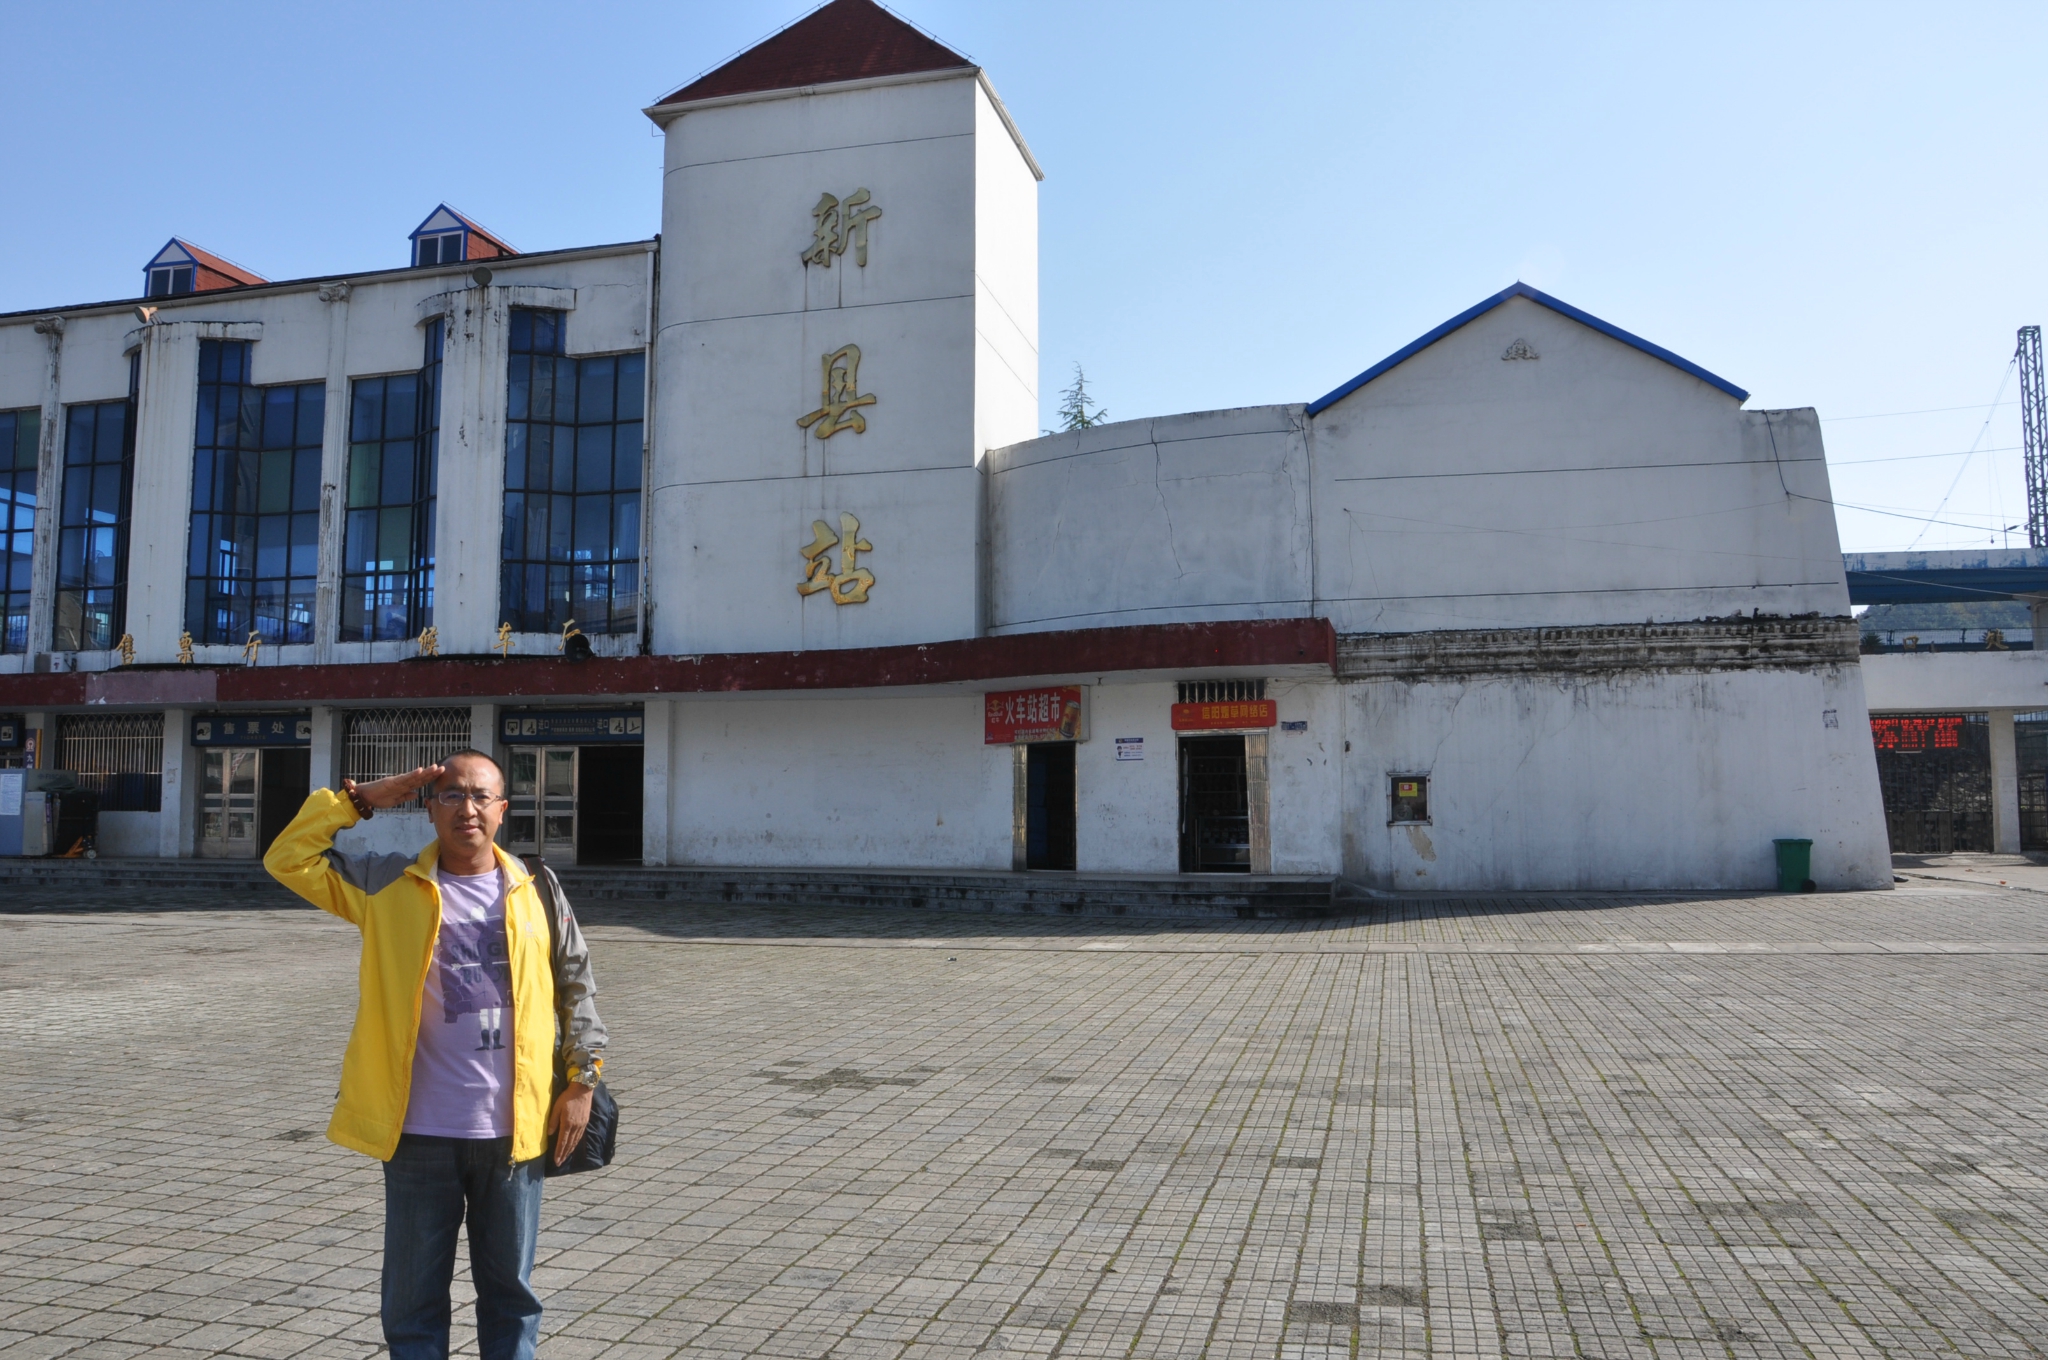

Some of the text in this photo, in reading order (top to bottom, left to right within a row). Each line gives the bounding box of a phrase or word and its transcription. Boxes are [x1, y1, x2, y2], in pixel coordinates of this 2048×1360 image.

[796, 186, 882, 607] 新县站
[115, 630, 262, 665] 售票厅
[1005, 692, 1060, 725] 火车站超市
[223, 721, 284, 735] 售票处
